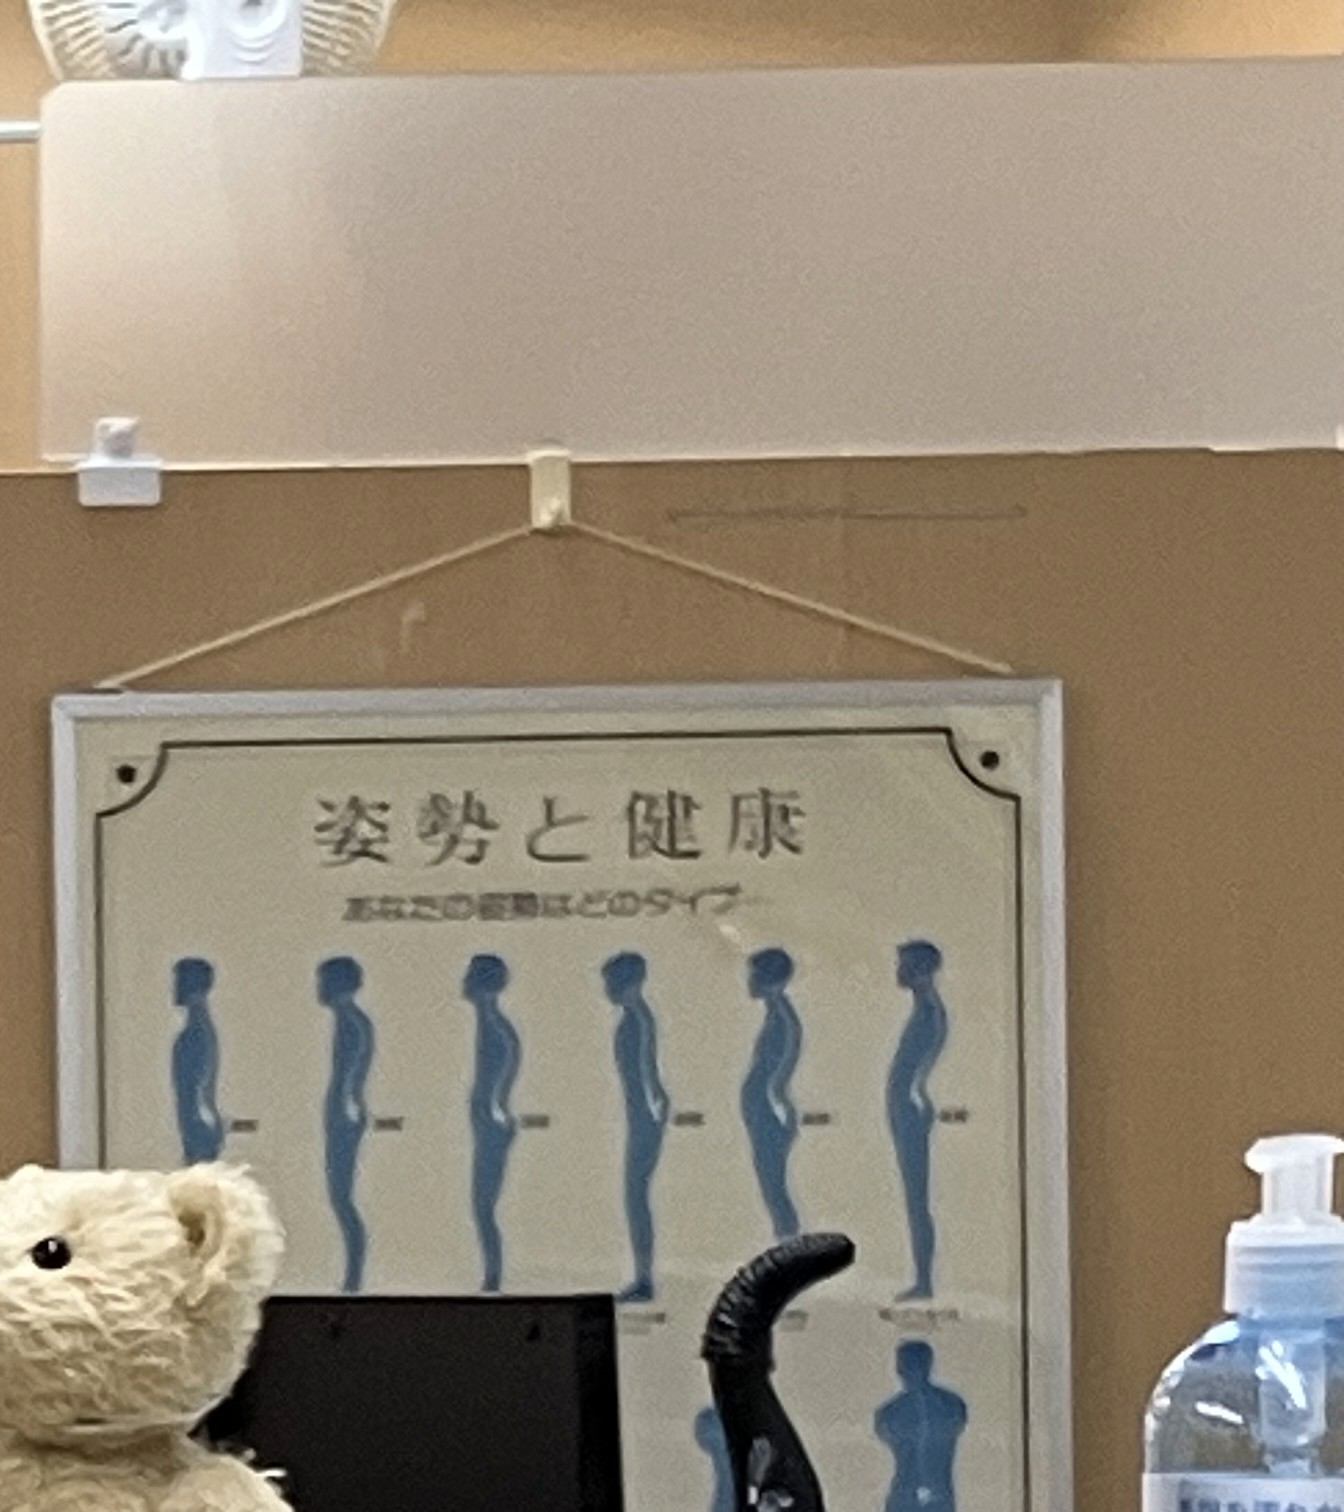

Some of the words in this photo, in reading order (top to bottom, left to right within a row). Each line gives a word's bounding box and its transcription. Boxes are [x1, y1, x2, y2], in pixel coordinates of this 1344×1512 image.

[314, 787, 806, 867] 姿勢と健康
